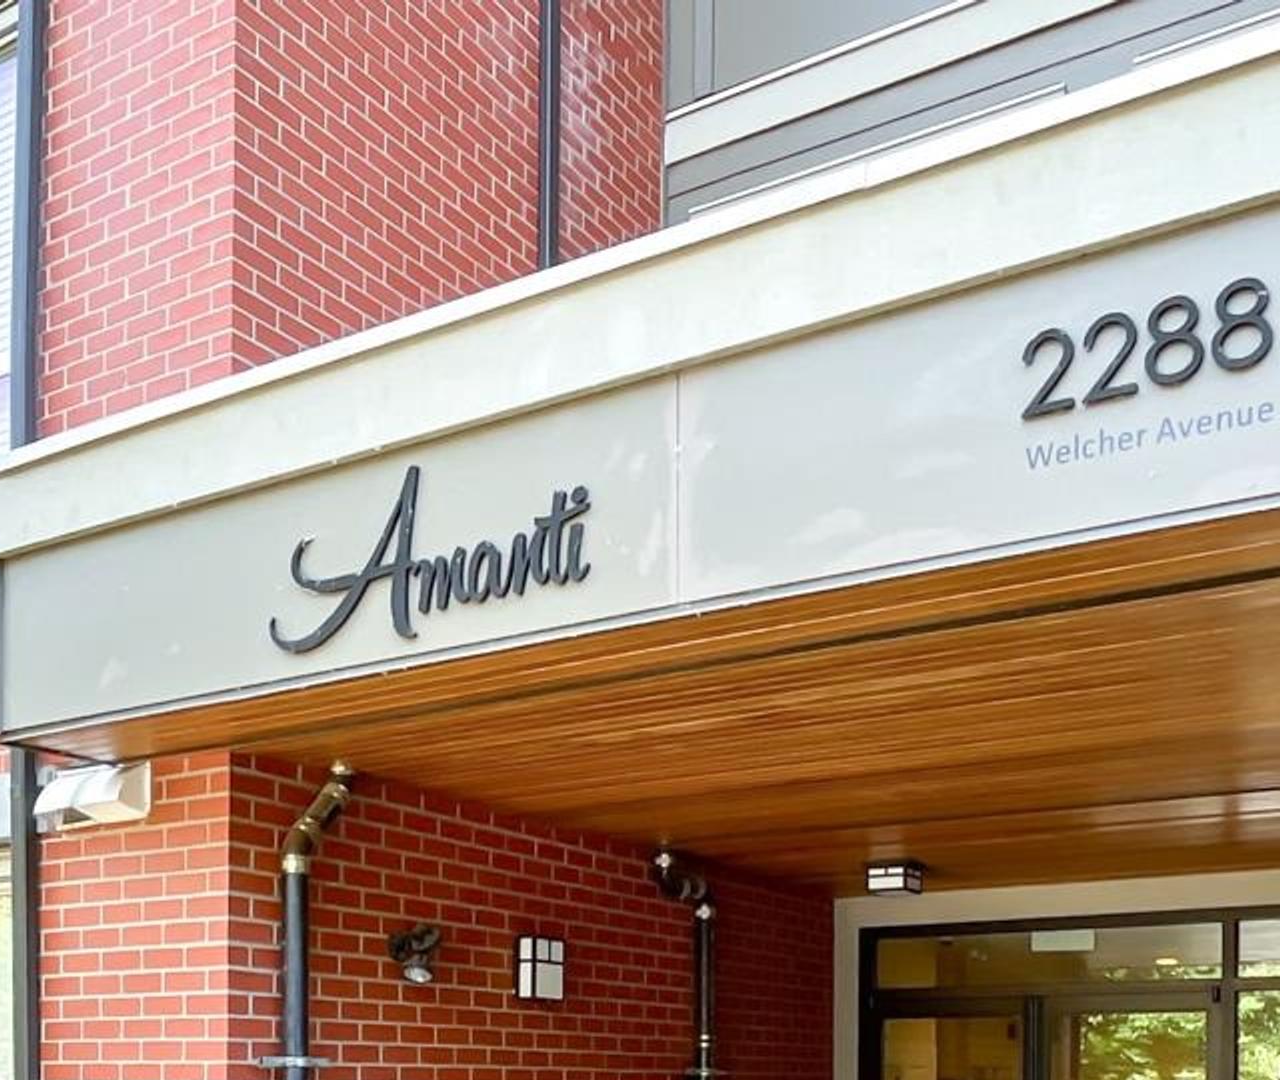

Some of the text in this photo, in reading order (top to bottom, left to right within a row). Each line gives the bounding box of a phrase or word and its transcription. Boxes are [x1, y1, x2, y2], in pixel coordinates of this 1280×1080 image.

[1021, 276, 1274, 421] 2288
[1025, 401, 1275, 470] Welcher Avenue
[269, 465, 592, 654] Amanti
